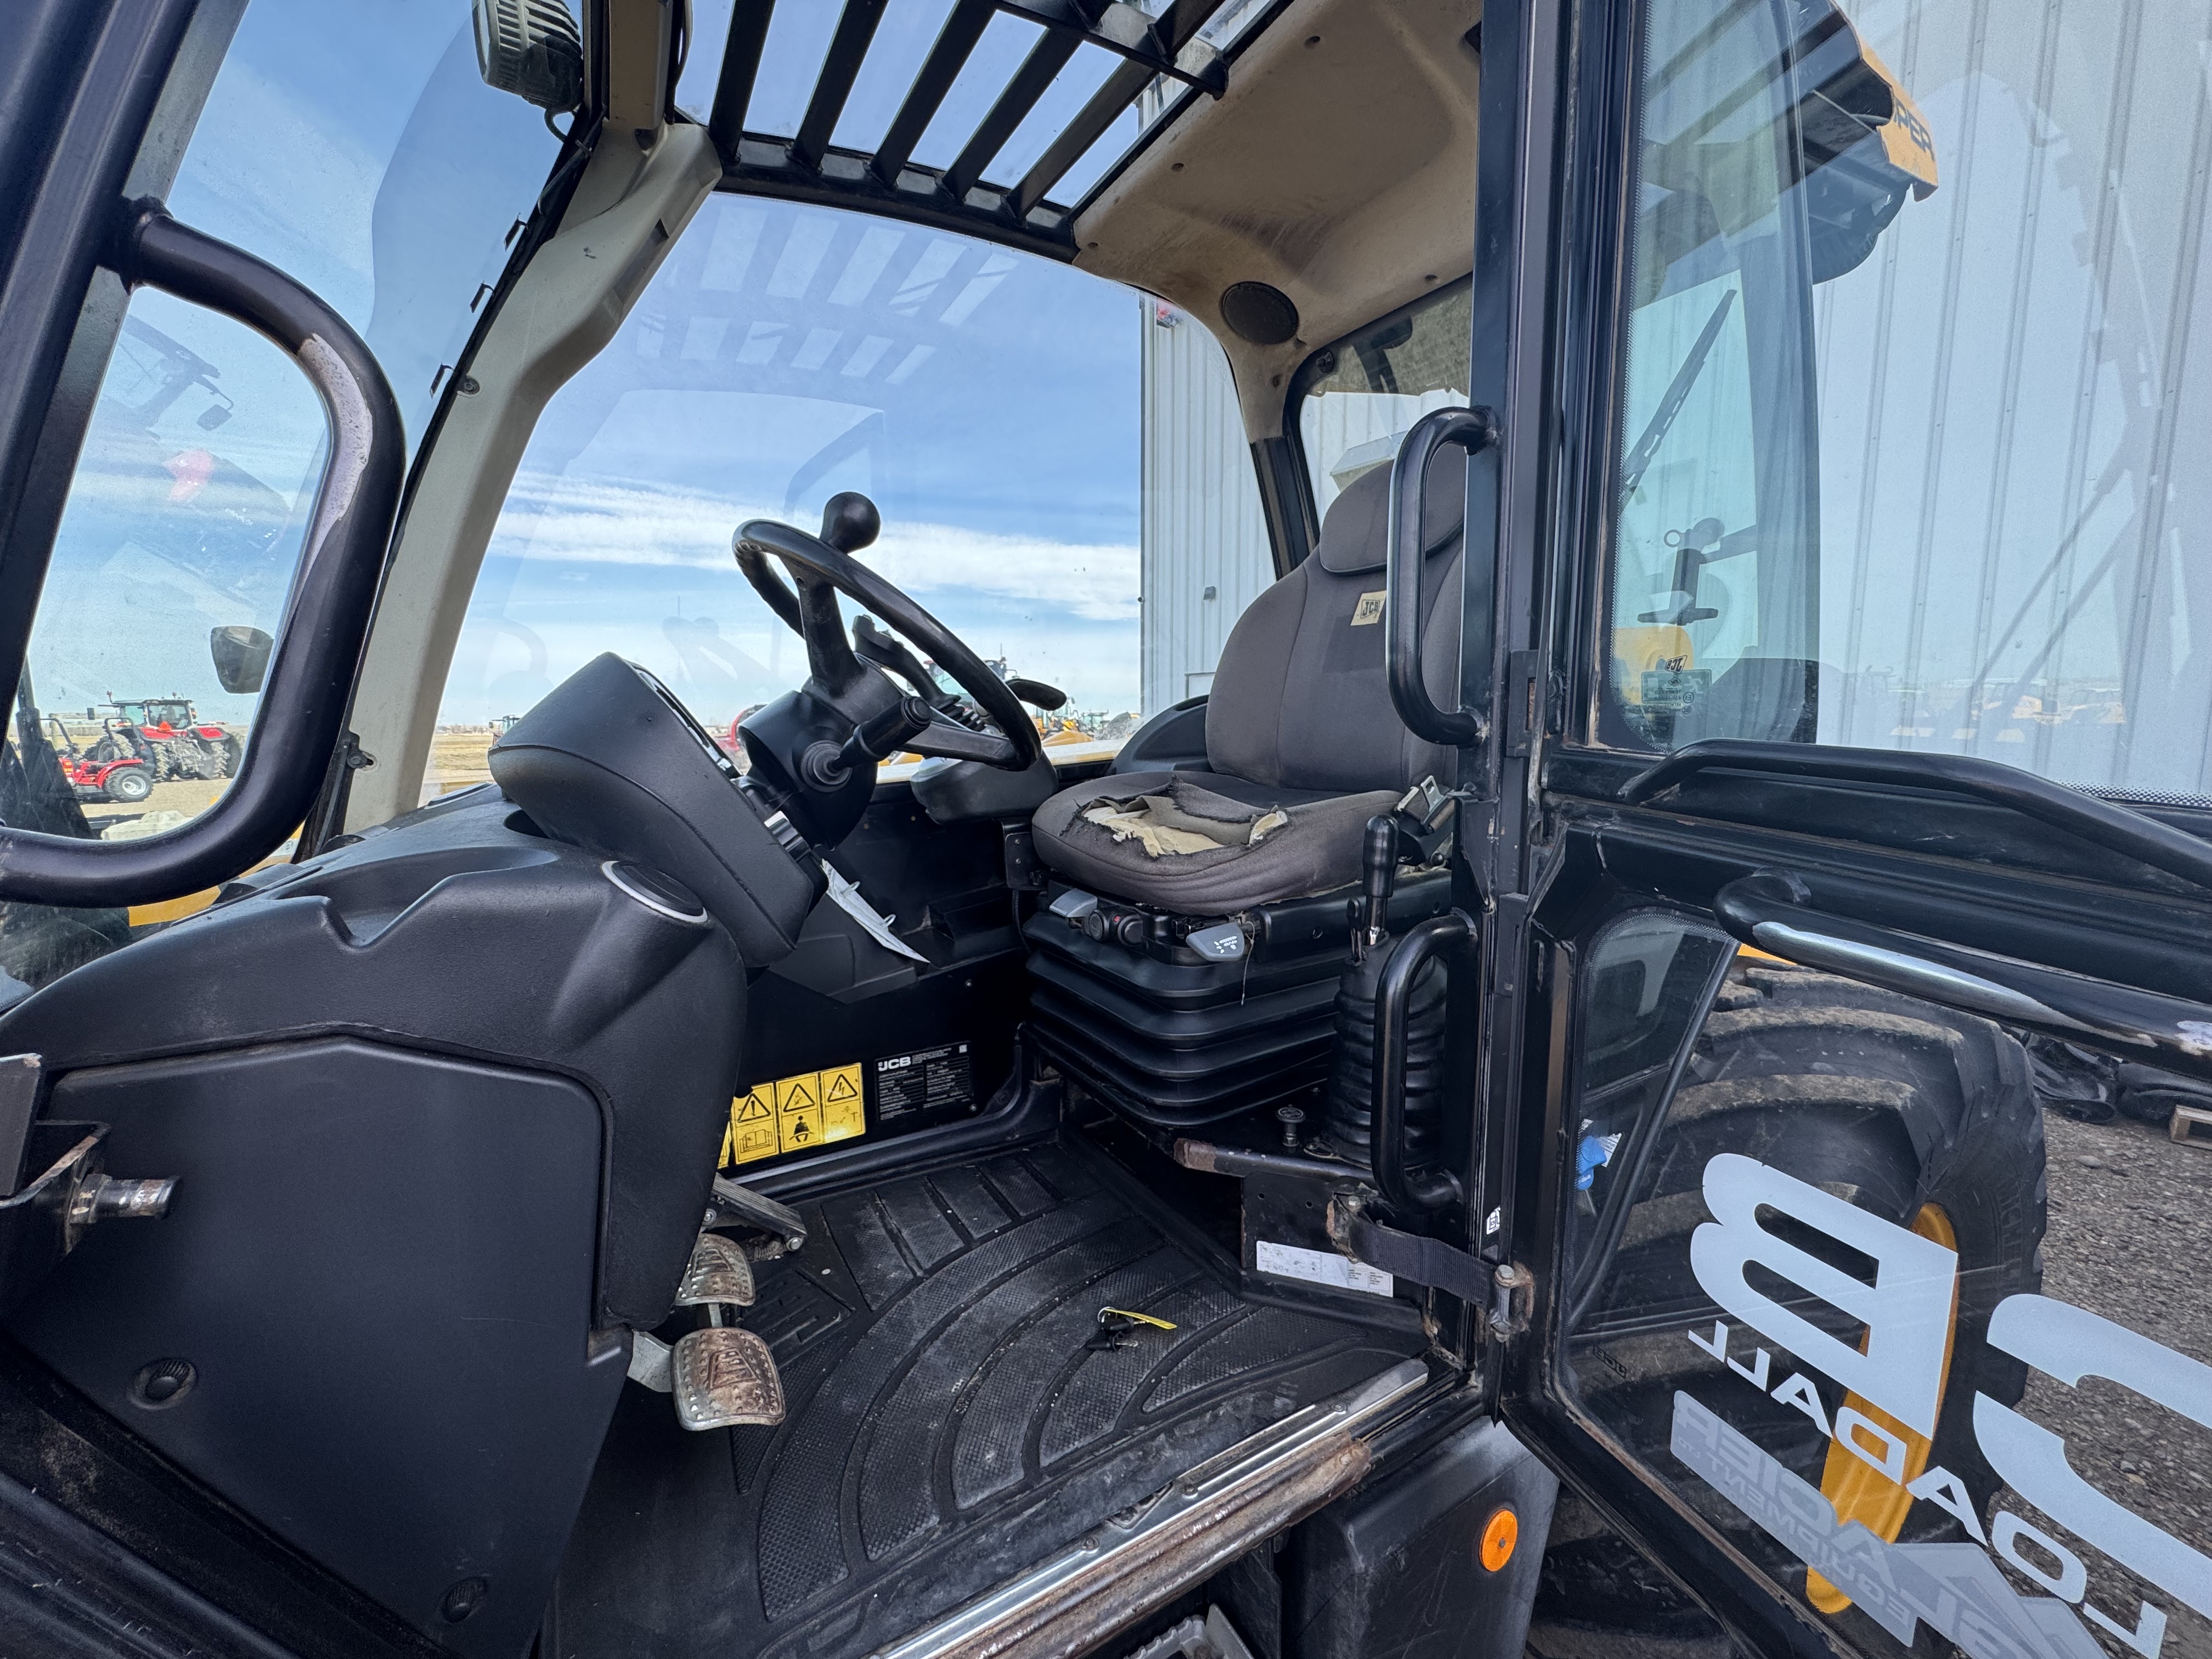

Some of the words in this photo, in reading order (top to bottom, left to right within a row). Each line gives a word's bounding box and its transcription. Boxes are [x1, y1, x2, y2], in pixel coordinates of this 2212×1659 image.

[1893, 98, 1935, 161] PER
[1362, 601, 1379, 617] JCB
[878, 1057, 911, 1071] JCB
